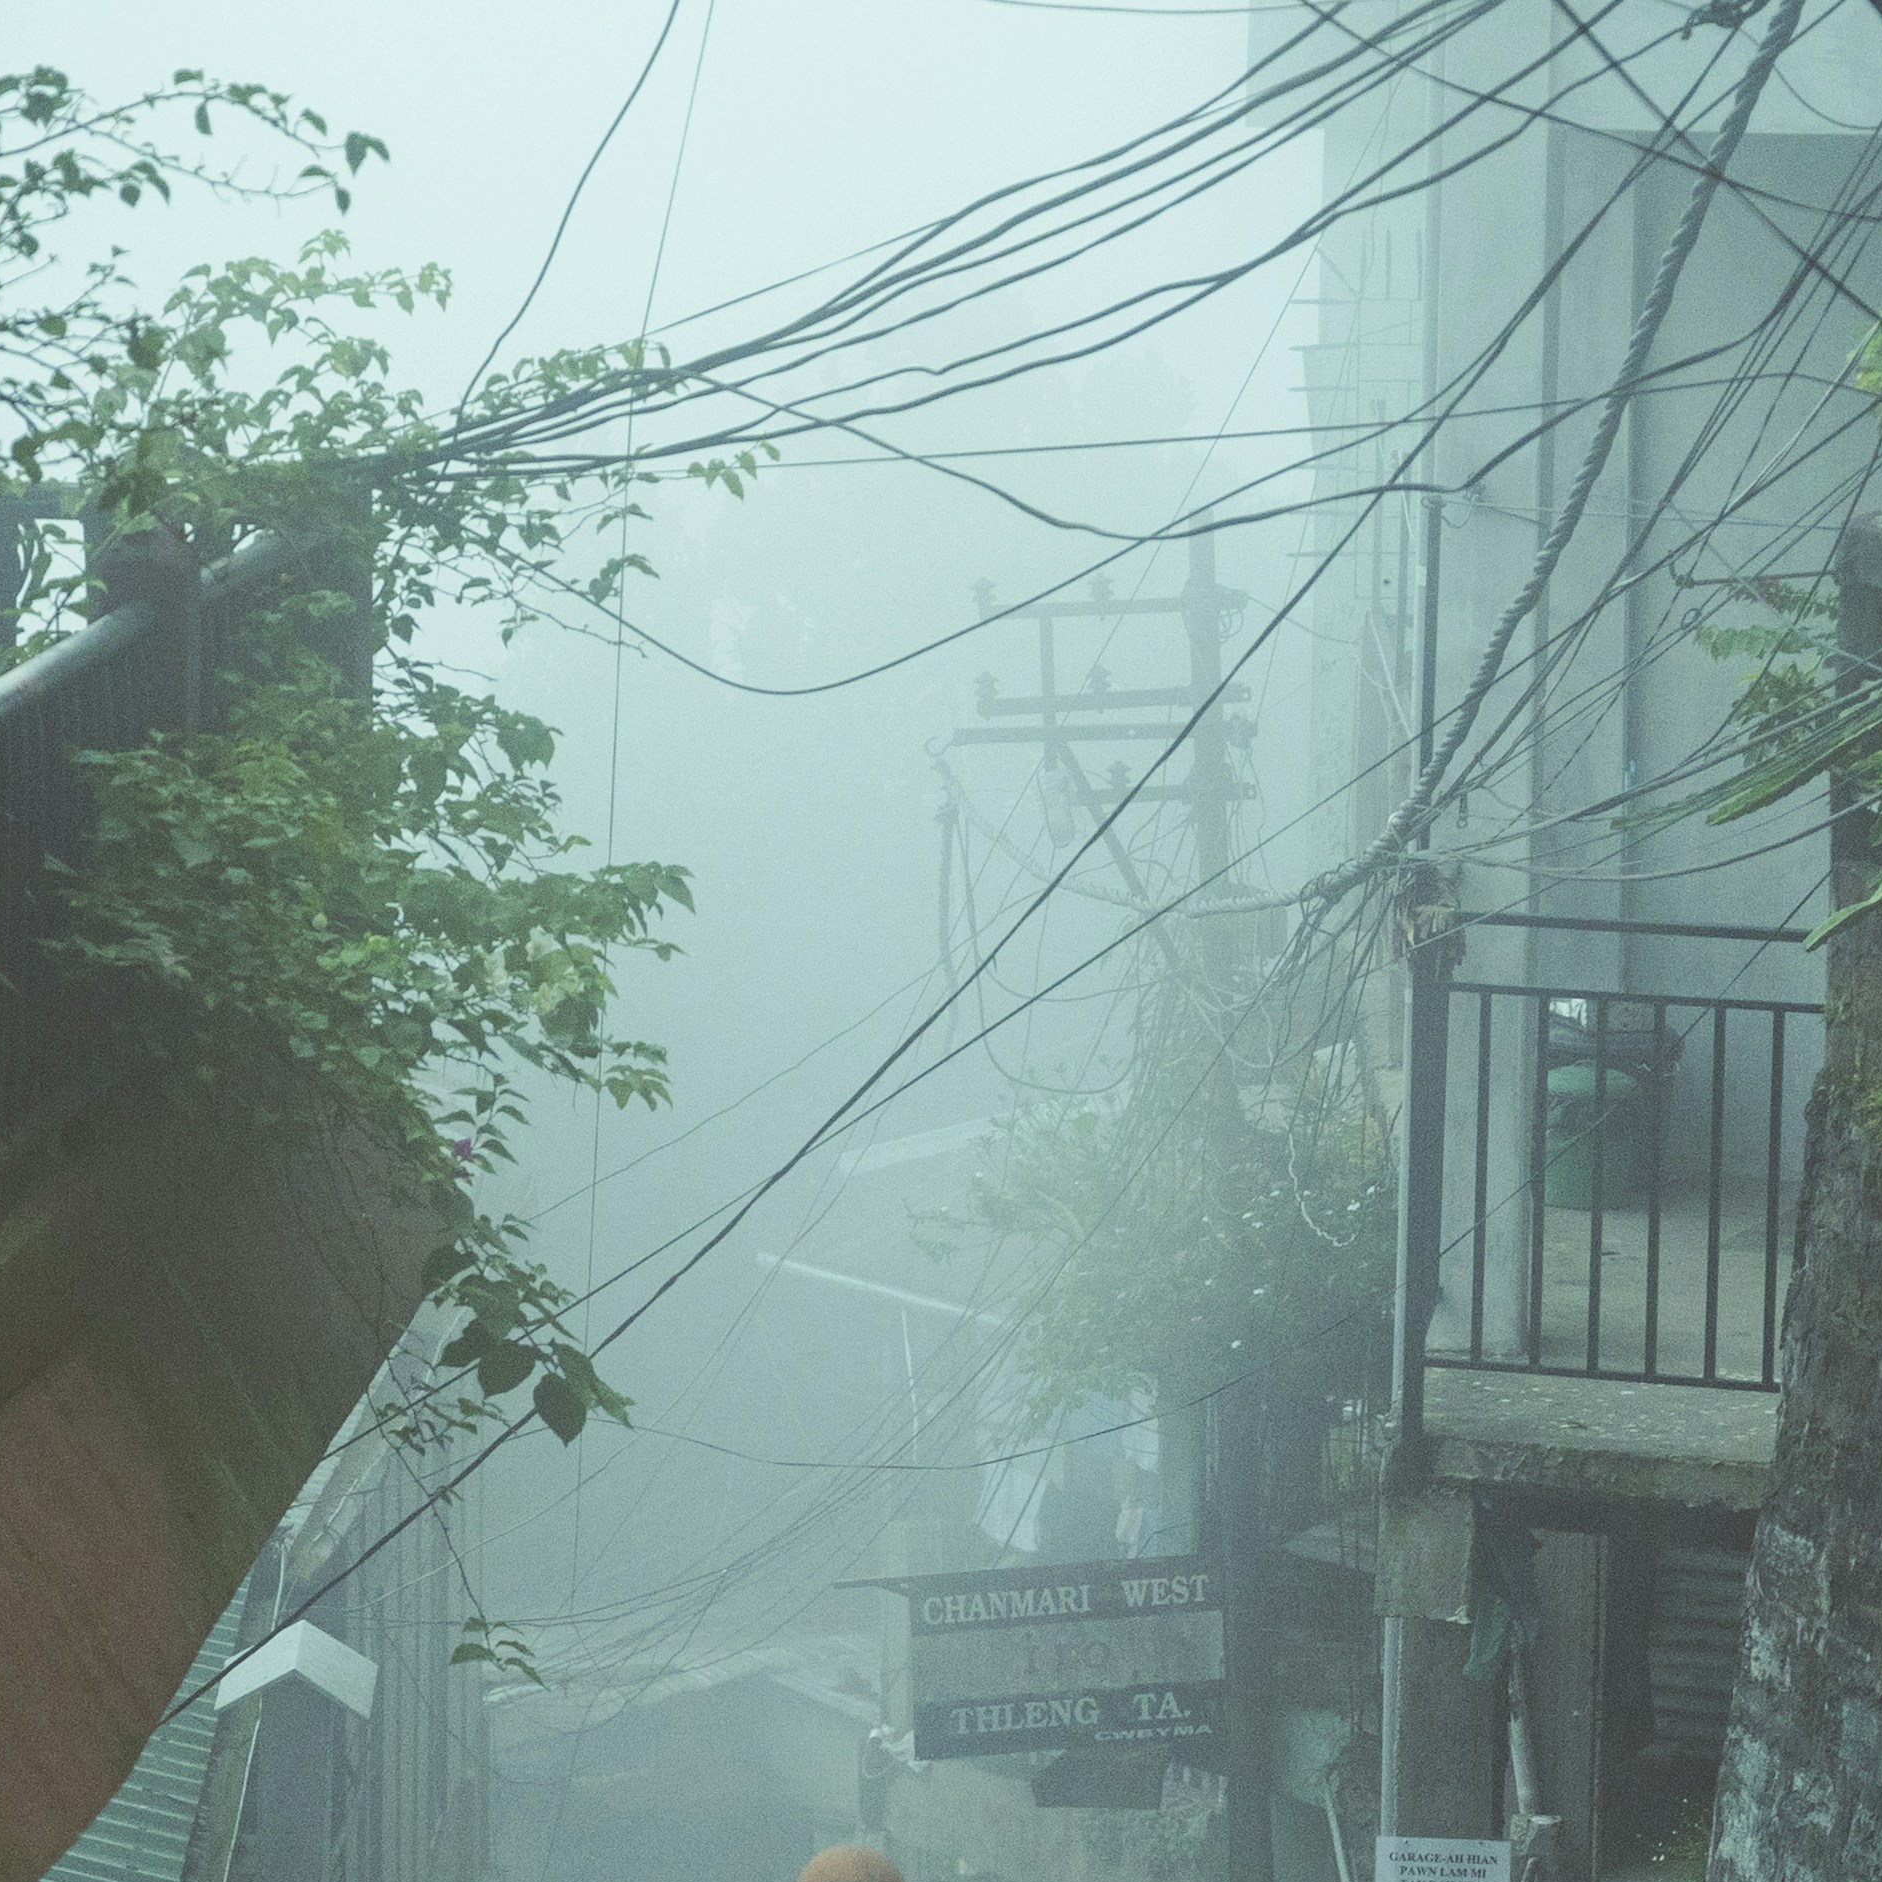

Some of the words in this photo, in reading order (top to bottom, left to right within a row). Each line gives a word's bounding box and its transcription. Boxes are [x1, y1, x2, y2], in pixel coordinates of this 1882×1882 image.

[921, 1584, 1092, 1626] CHANMARI
[1121, 1574, 1210, 1608] WEST
[950, 1696, 1101, 1736] THLENG
[1132, 1691, 1193, 1722] TA.
[1389, 1851, 1464, 1865] GARAGE-AH
[1466, 1853, 1499, 1866] HIAN
[1399, 1865, 1437, 1877] PAWN
[1439, 1866, 1468, 1878] LAM
[1470, 1867, 1487, 1879] MI
